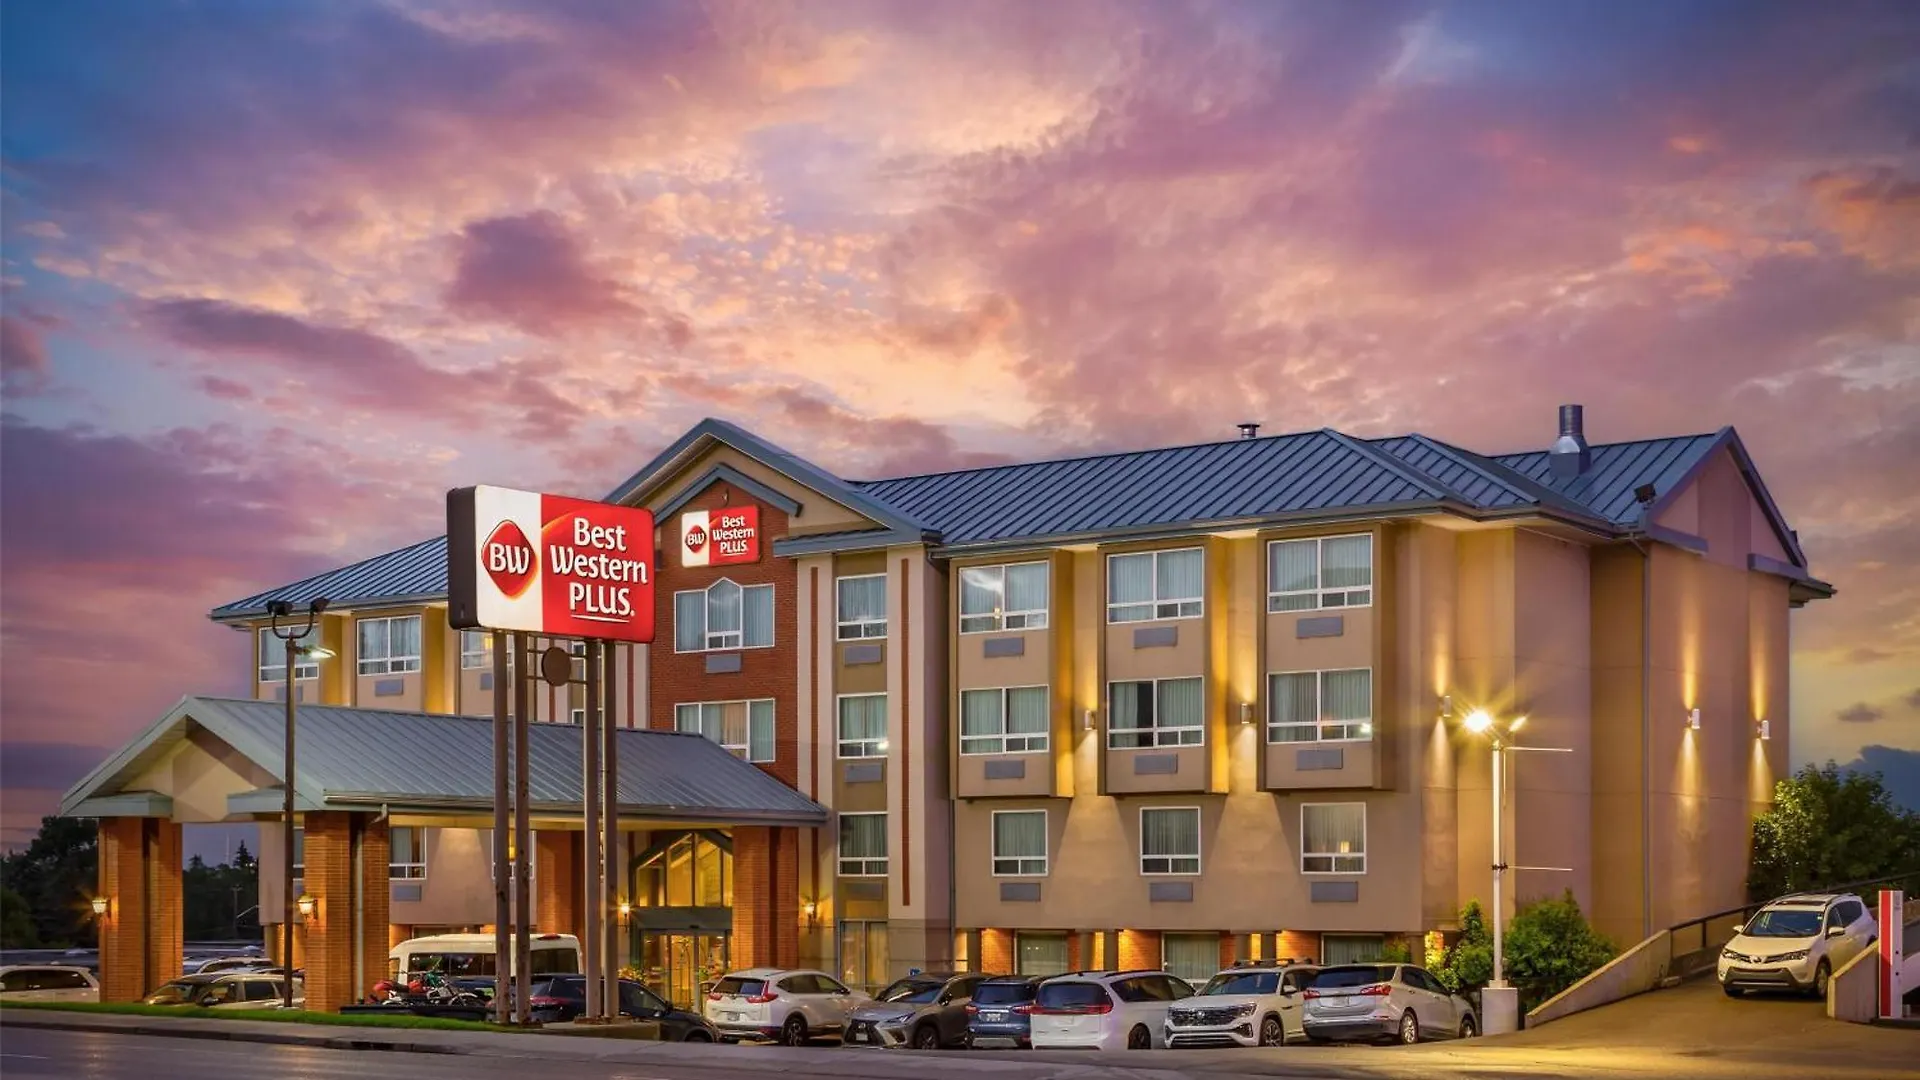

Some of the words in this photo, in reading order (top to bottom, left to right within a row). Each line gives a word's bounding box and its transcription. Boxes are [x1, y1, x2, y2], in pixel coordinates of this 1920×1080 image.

[722, 515, 746, 528] Best
[574, 517, 627, 551] Best
[687, 532, 705, 546] BW
[712, 528, 755, 541] Western
[720, 540, 748, 553] PLUS
[489, 543, 530, 575] BW
[550, 545, 648, 584] Western
